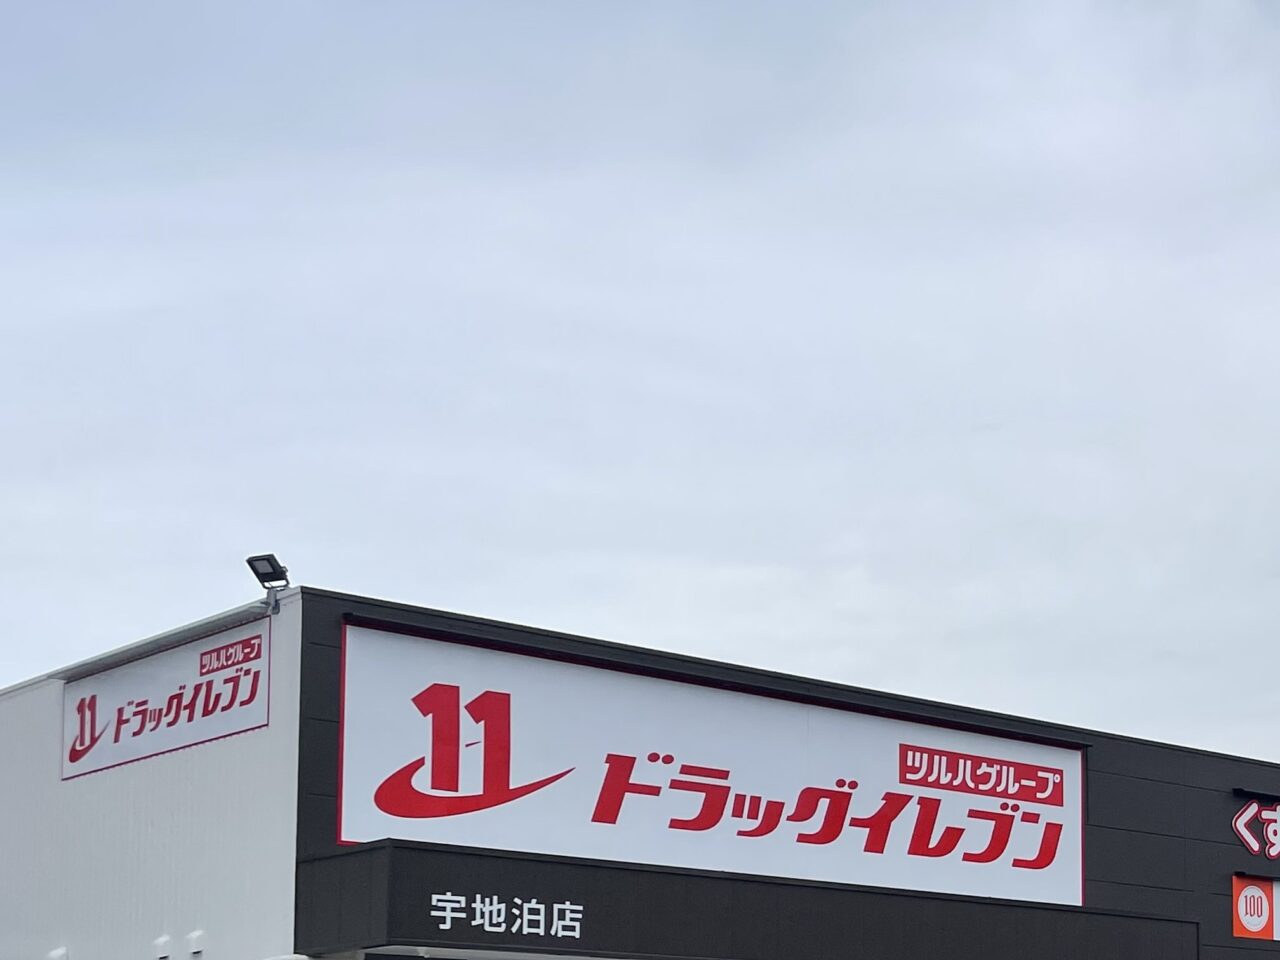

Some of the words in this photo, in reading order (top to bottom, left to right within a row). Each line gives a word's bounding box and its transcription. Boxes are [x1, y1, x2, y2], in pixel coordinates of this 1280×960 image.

[113, 667, 262, 745] ドラッグイレブン
[905, 750, 1062, 799] ツルハグループ
[590, 751, 1064, 870] ドラッグイレブン
[430, 891, 584, 939] 宇地泊店
[1244, 894, 1263, 918] 100
